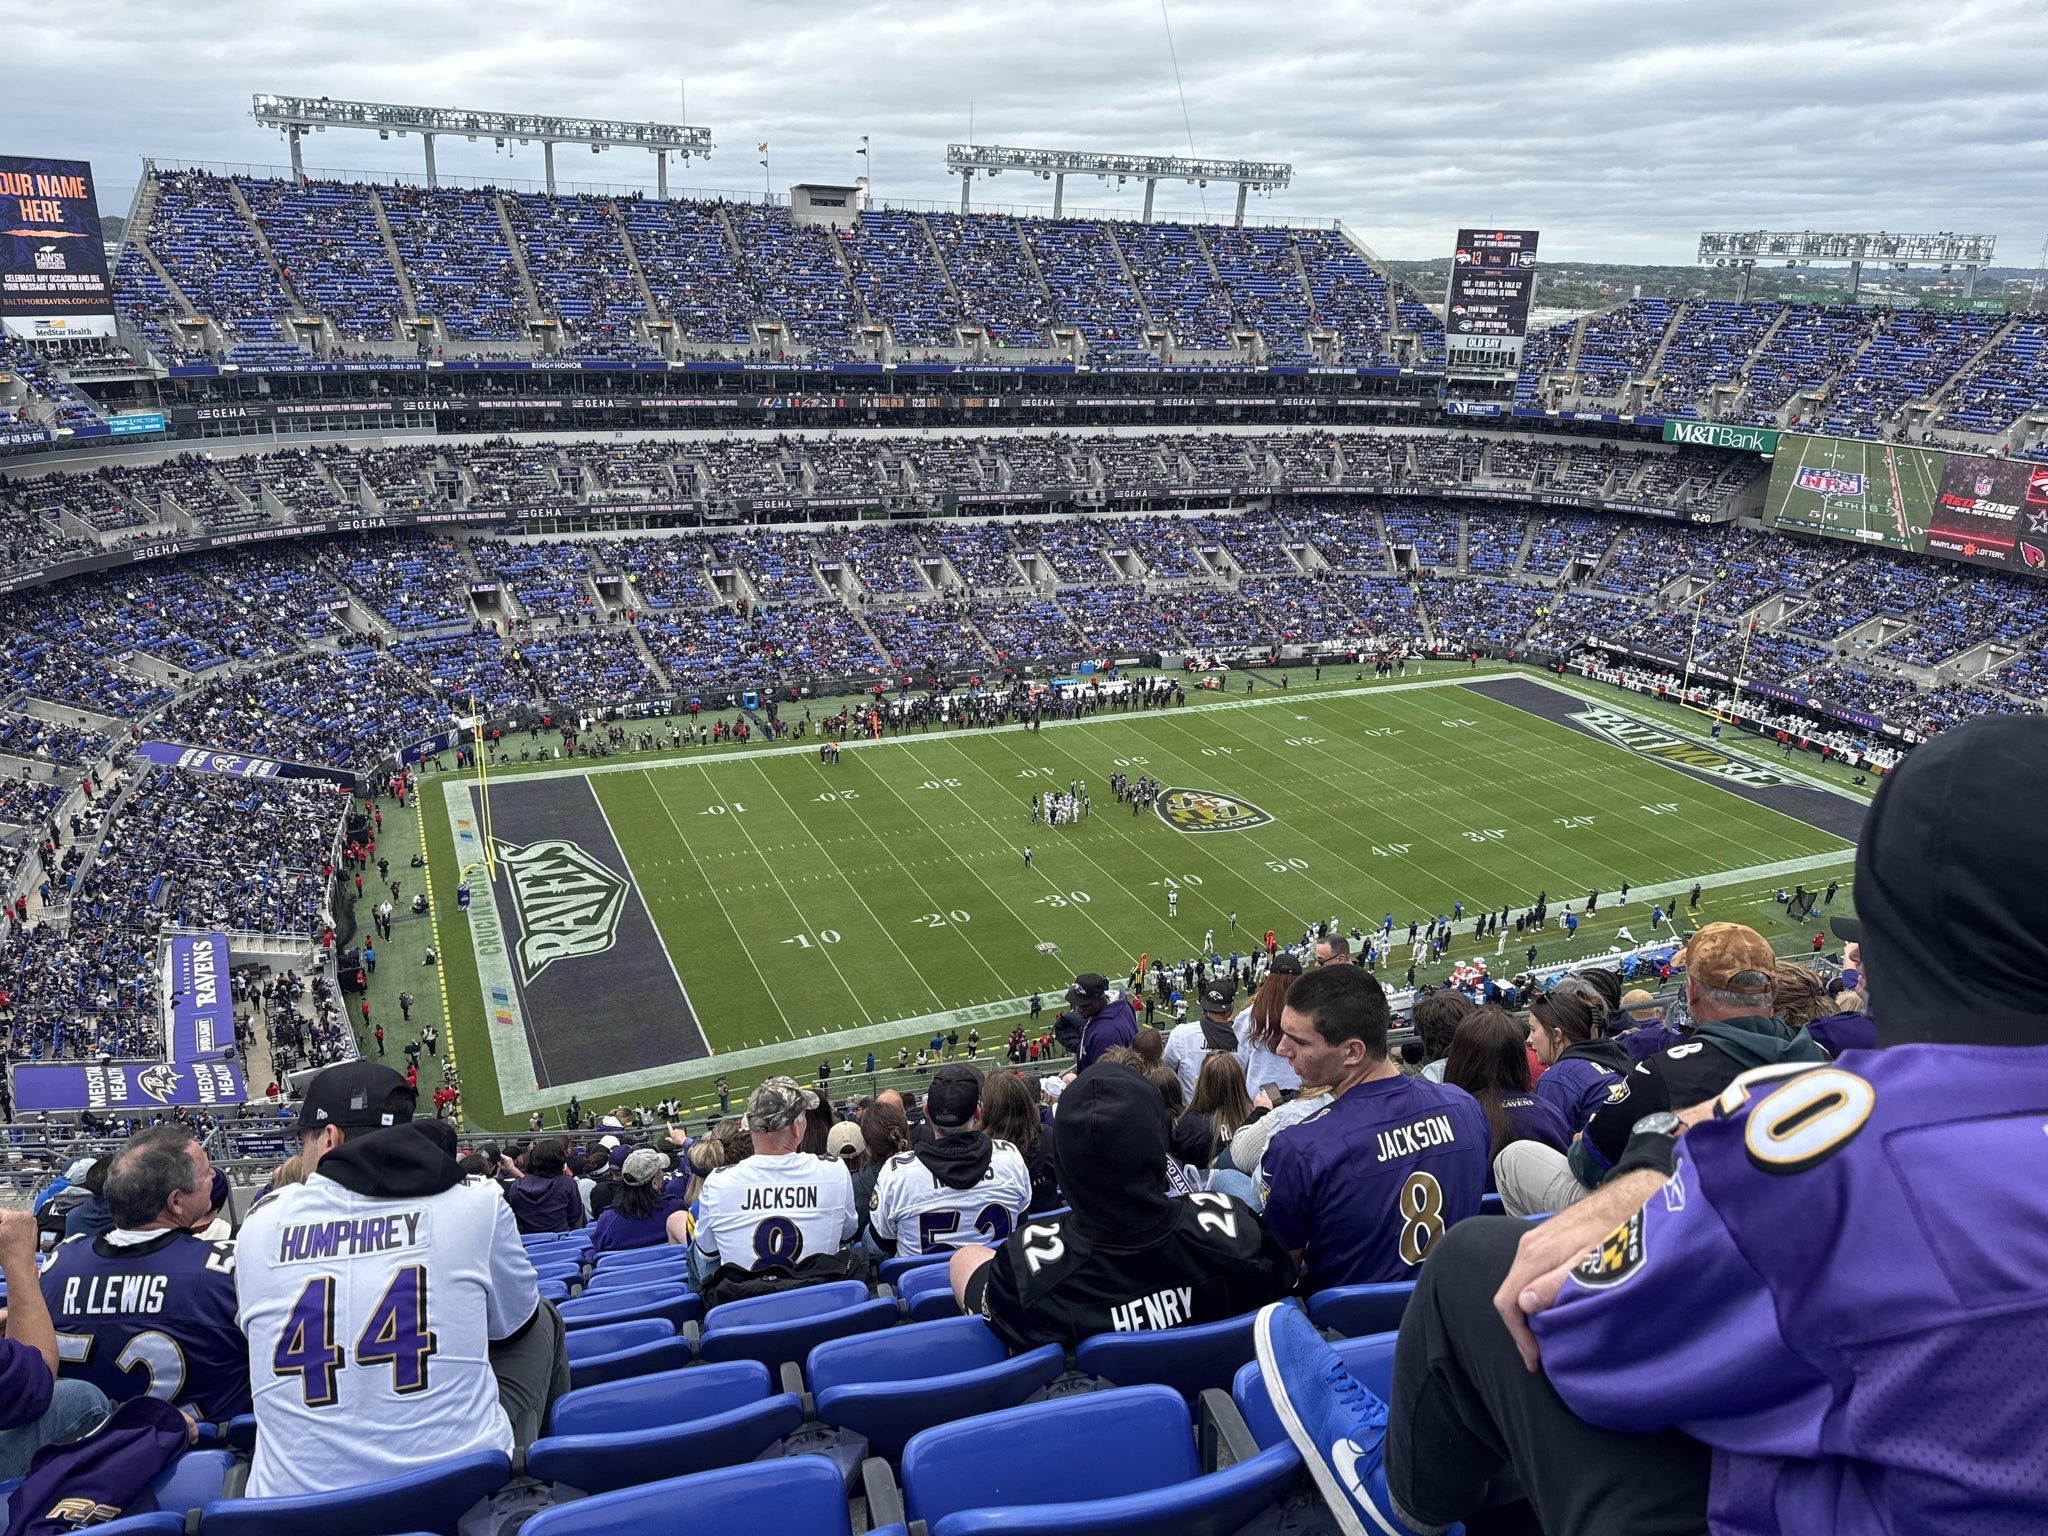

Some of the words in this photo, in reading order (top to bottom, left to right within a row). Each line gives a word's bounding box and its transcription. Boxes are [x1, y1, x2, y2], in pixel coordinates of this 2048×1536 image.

[37, 175, 88, 199] NAME
[19, 199, 64, 223] HERE
[35, 252, 59, 263] CAWS
[1472, 251, 1482, 265] 13
[1509, 252, 1519, 266] 11
[4, 274, 36, 283] CELEBRATE
[37, 275, 48, 283] ANY
[49, 275, 77, 283] OCCASION
[78, 275, 89, 283] AND
[90, 275, 100, 283] SEE
[3, 283, 19, 291] YOUR
[20, 283, 47, 291] MESSAGE
[48, 283, 56, 291] ON
[57, 283, 67, 291] THE
[67, 283, 84, 291] VIDEO
[3, 297, 110, 306] BALTIMORERAVENS.COM/CAWS
[1856, 294, 1890, 304] HONOR
[1891, 296, 1920, 306] ROWS
[35, 328, 68, 337] MedStar
[68, 328, 92, 336] Health
[1468, 338, 1484, 348] OLD
[1485, 339, 1501, 349] BAY
[321, 404, 341, 412] BENEFITS
[417, 401, 449, 410] G.E.H.A
[584, 399, 614, 408] G.E.H.A
[786, 398, 792, 407] 0
[831, 398, 836, 407] 0
[873, 398, 879, 407] 10
[912, 398, 925, 407] 12:20
[964, 398, 984, 407] TIMEOUT
[1031, 399, 1055, 407] G.E.H.A
[1293, 398, 1316, 406] G.E.H.A
[1469, 404, 1494, 412] merritt
[212, 408, 247, 418] G.E.H.A
[11, 432, 45, 444] 410-324-6141
[1672, 422, 1720, 445] M&T
[1719, 428, 1765, 451] Bank
[1124, 489, 1148, 497] G.E.H.A
[1393, 487, 1418, 495] G.E.H.A
[1976, 483, 1992, 495] NFL
[764, 500, 792, 509] G.E.H.A
[1552, 496, 1579, 506] G.E.H.A
[1834, 500, 1859, 510] 4TH
[1869, 505, 1878, 513] 8
[417, 514, 432, 523] PROUD
[432, 514, 451, 522] PARTNER
[452, 513, 457, 521] OF
[466, 512, 490, 520] BALTIMORE
[490, 511, 506, 519] RAVENS
[530, 508, 562, 518] G.E.H.A
[1691, 512, 1711, 523] 12:20
[1808, 510, 1839, 521] 50
[1971, 510, 2014, 521] NETWORK
[352, 518, 386, 529] G.E.H.A
[211, 537, 228, 546] HEALTH
[237, 533, 253, 542] DENTAL
[253, 531, 274, 540] BENEFITS
[275, 529, 283, 537] FOR
[283, 527, 302, 536] FEDERAL
[302, 524, 326, 534] EMPLOYEES
[146, 543, 180, 558] G.E.H.A
[1930, 539, 1963, 551] MARYLAND
[1976, 548, 2004, 559] LOTTERY
[1767, 688, 1798, 702] SEASONS
[1441, 719, 1474, 728] 10
[1832, 709, 1873, 726] 1996-2025
[1364, 727, 1400, 737] 20
[1285, 736, 1320, 747] 30
[1570, 704, 1792, 788] BALTIMORE
[1201, 746, 1234, 757] 40
[1114, 756, 1150, 767] 50
[1021, 767, 1055, 778] 40
[923, 778, 962, 790] 30
[819, 789, 860, 802] 20
[708, 802, 748, 815] 10
[1640, 803, 1675, 815] 10
[1187, 816, 1263, 830] RAVENS
[1553, 816, 1590, 829] 20
[1462, 828, 1502, 843] 30
[1372, 842, 1410, 857] 40
[1264, 857, 1309, 873] 50
[1163, 874, 1203, 889] 40
[1045, 890, 1091, 908] 30
[493, 838, 628, 986] RAVENS
[922, 910, 971, 928] 20
[471, 901, 502, 956] CRUCIAL
[793, 929, 842, 948] 10
[183, 952, 191, 995] BALTIMORE
[193, 940, 217, 1008] RAVENS
[1377, 1115, 1455, 1162] JACKSON
[741, 1186, 818, 1210] JACKSON
[1189, 1192, 1237, 1238] 22
[1398, 1171, 1446, 1266] 8
[280, 1211, 421, 1263] HUMPHREY
[1023, 1222, 1065, 1277] 22
[63, 1275, 168, 1315] R.LEWIS
[1110, 1286, 1192, 1332] HENRY
[273, 1264, 437, 1408] 44
